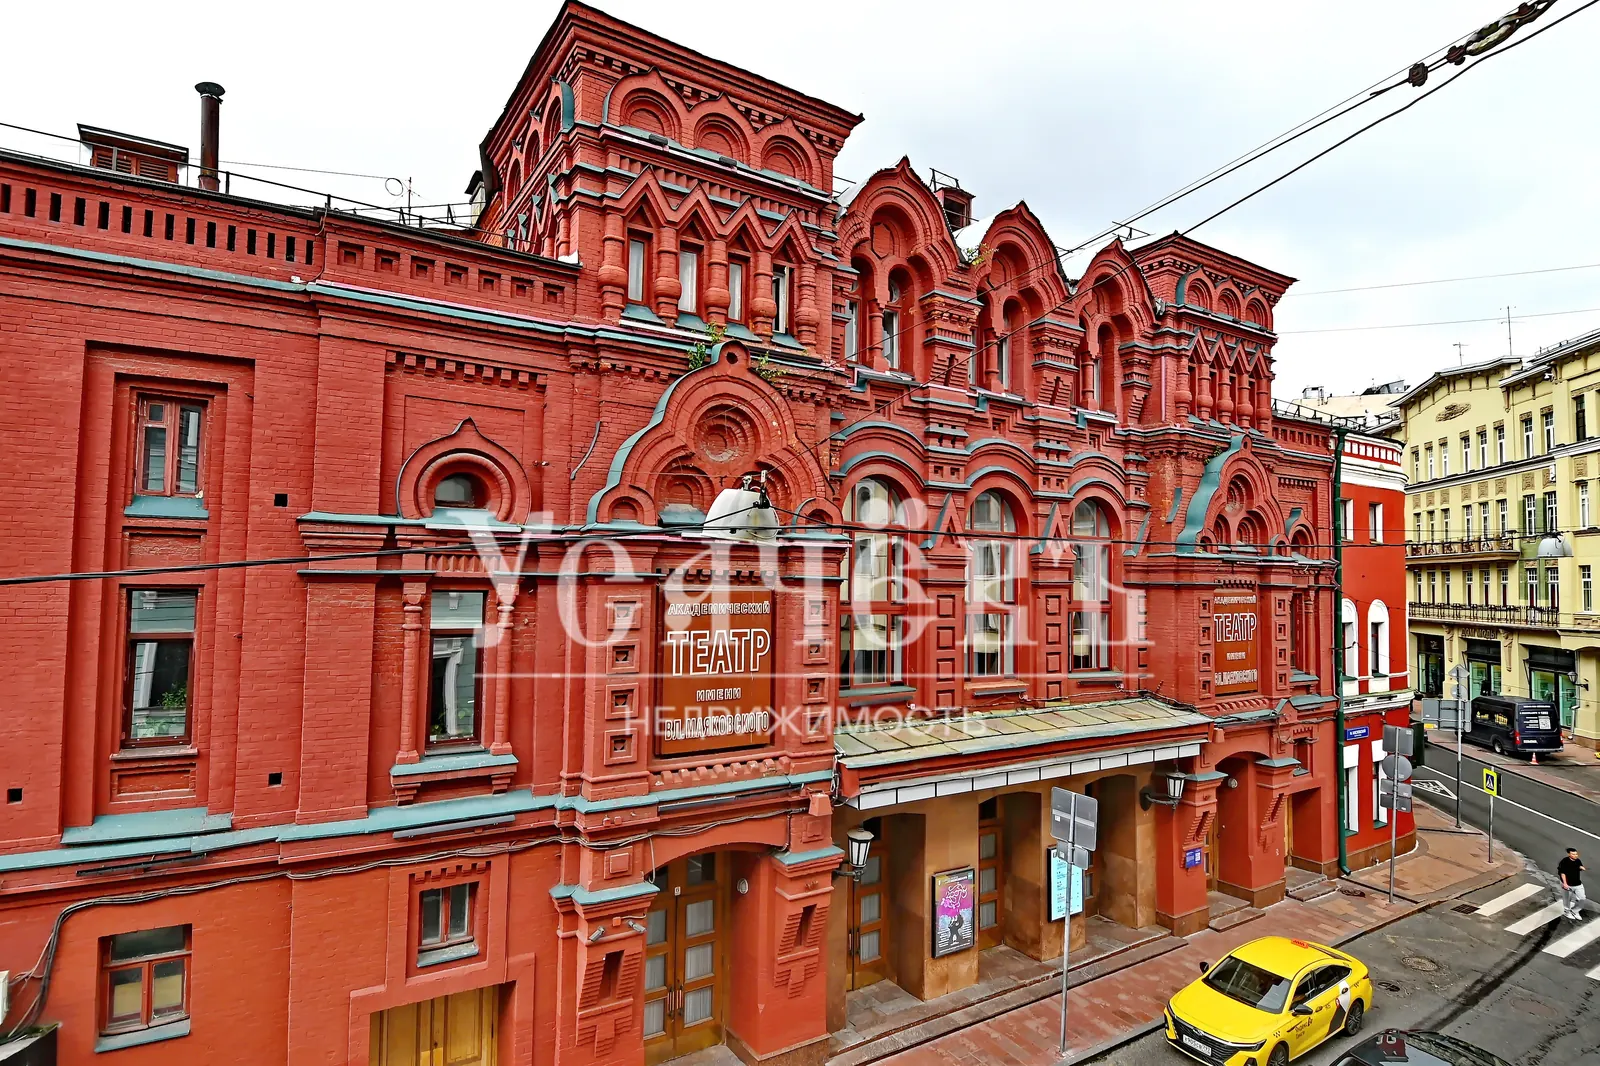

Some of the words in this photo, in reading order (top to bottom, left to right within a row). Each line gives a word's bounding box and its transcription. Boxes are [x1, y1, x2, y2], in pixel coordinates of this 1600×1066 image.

[668, 601, 770, 616] АКАДЕМИЧЕСКИЙ
[1214, 612, 1257, 642] ТЕАТР
[667, 628, 770, 676] ТЕАТР
[696, 687, 741, 702] ИМЕНИ
